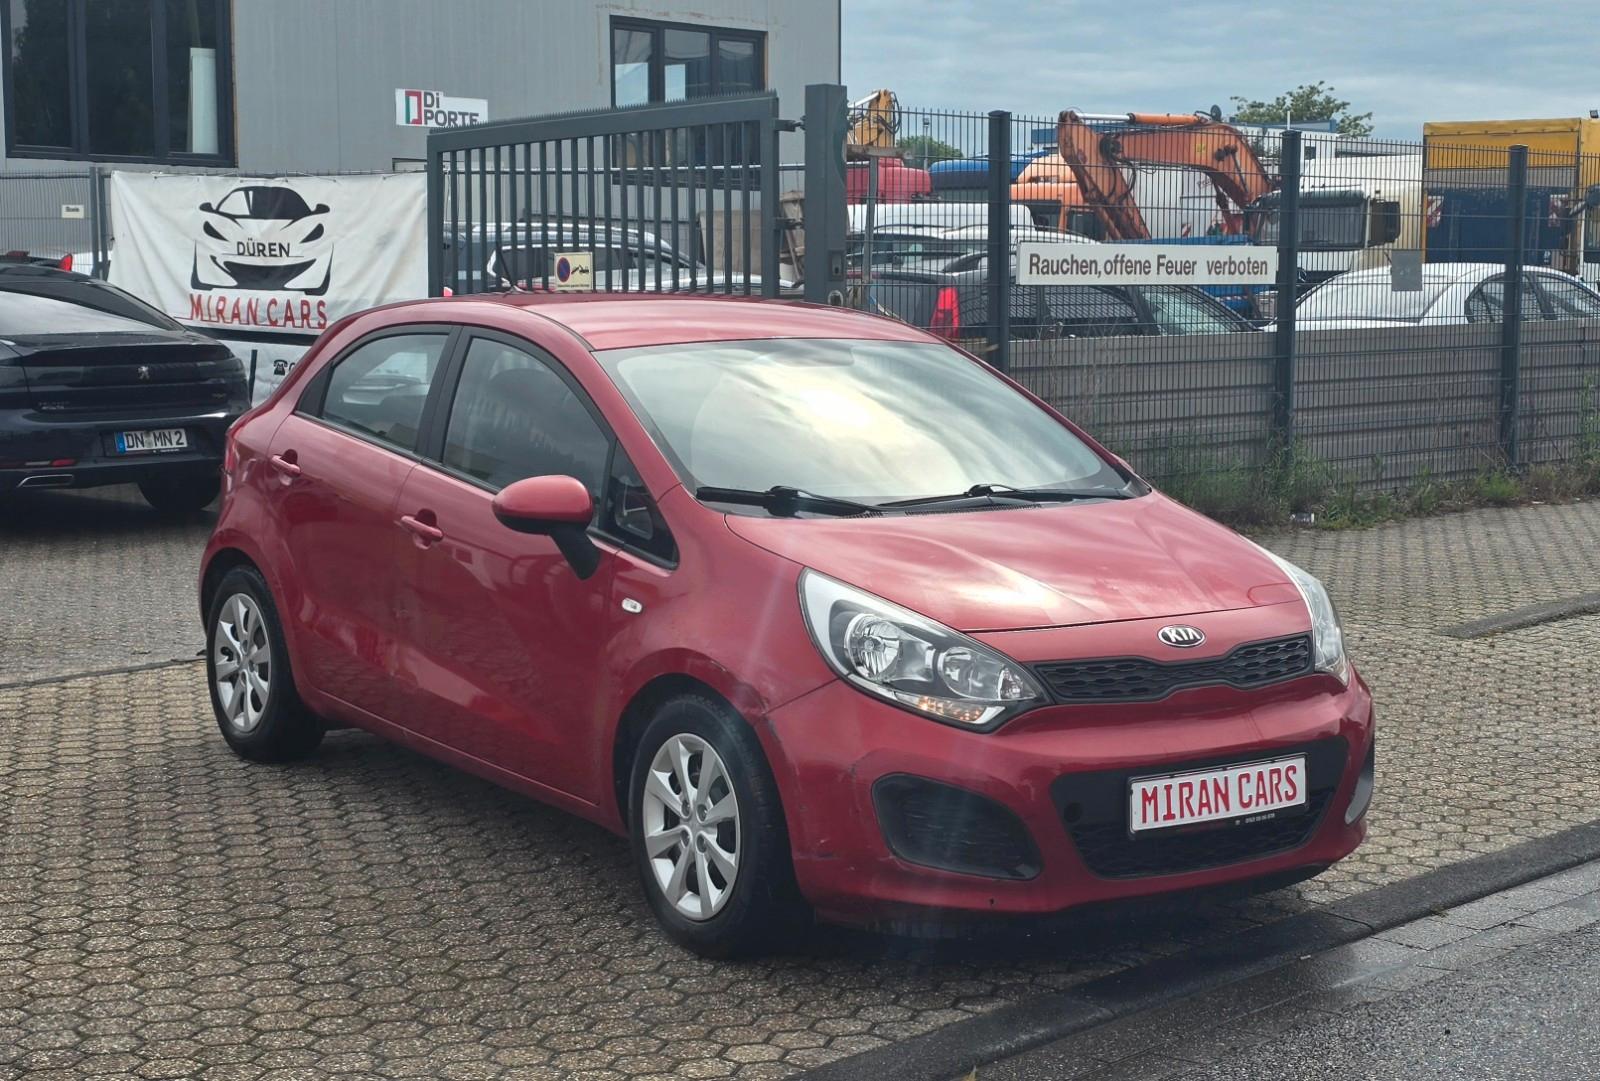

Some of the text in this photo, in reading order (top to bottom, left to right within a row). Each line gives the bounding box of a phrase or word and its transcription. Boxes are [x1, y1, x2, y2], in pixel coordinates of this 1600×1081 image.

[423, 91, 441, 109] Di
[236, 237, 290, 257] DÜREN
[1029, 253, 1268, 278] Rauchen, offene Feuer verboten
[189, 293, 327, 329] MIRAN CARS
[126, 430, 184, 448] DN MN 2
[1164, 627, 1202, 642] KIA
[1141, 764, 1297, 824] MIRAN CARS
